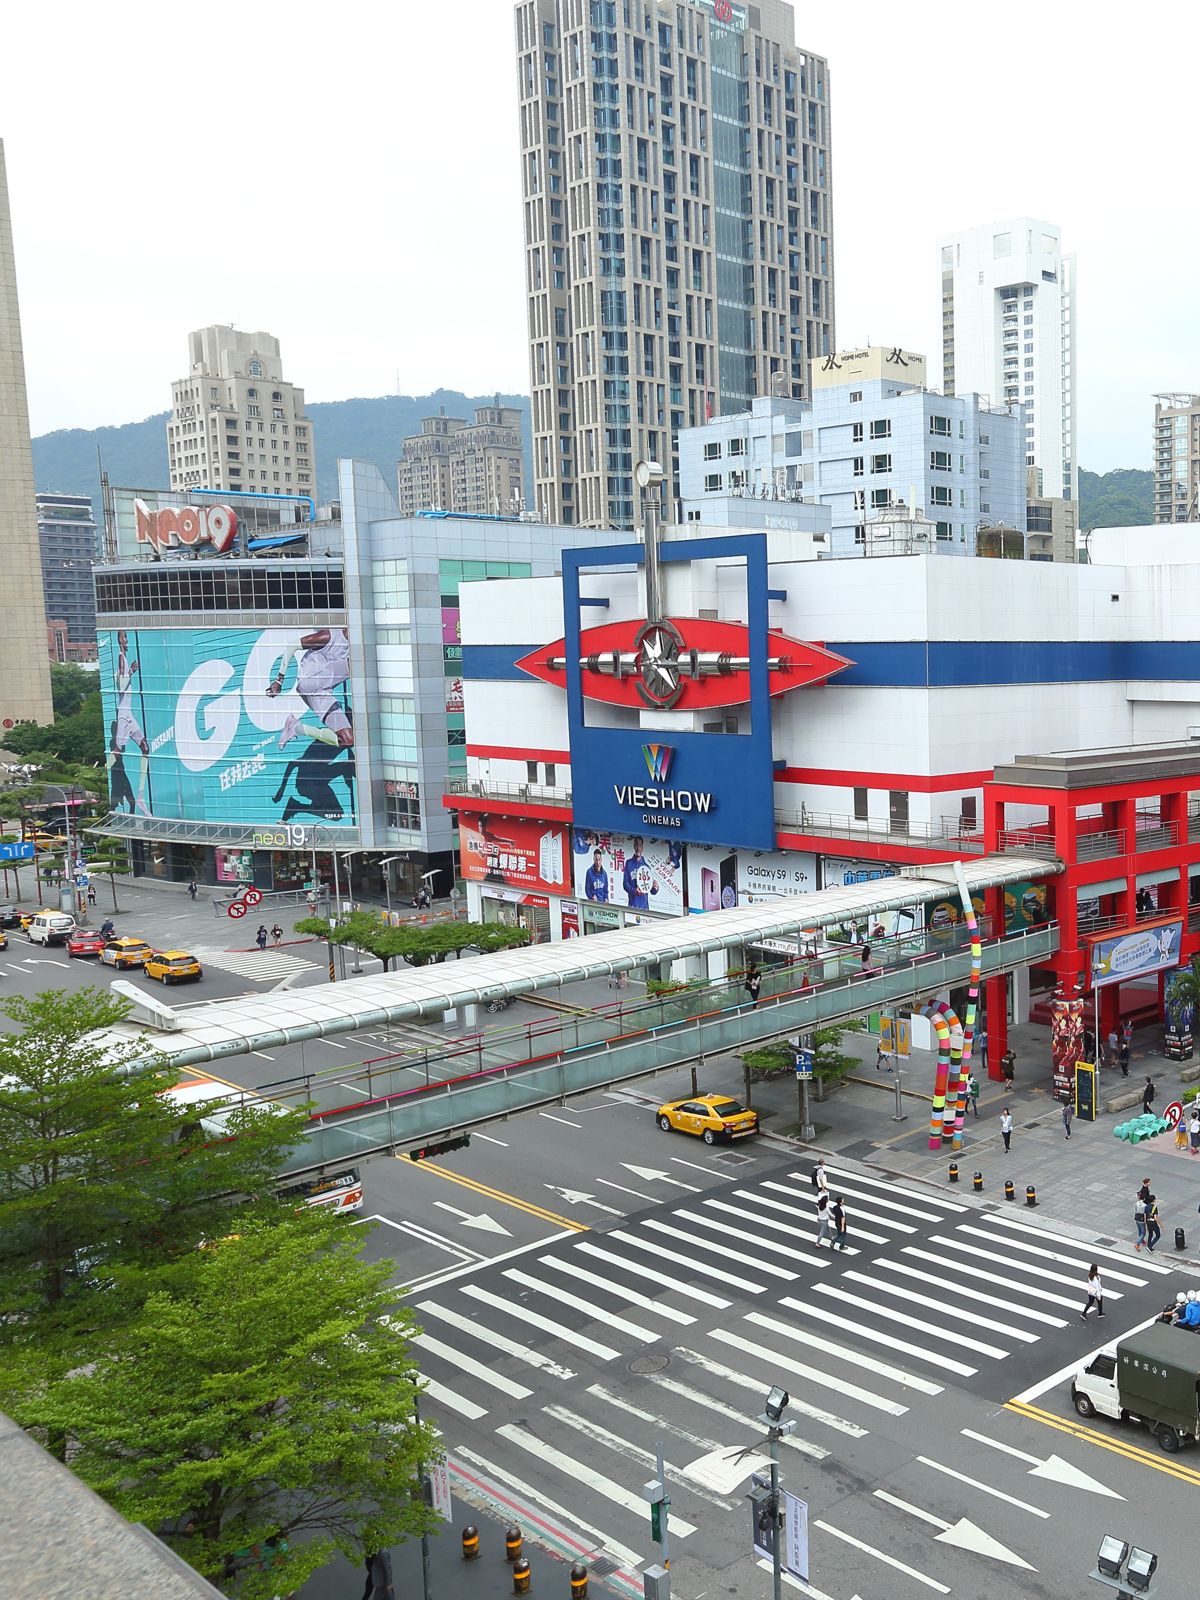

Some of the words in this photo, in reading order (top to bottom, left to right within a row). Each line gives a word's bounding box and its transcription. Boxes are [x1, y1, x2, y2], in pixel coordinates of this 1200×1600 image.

[614, 784, 711, 813] VIESHOW
[642, 814, 681, 827] CINEMAS
[747, 866, 776, 880] Galaxy
[777, 869, 786, 880] S9
